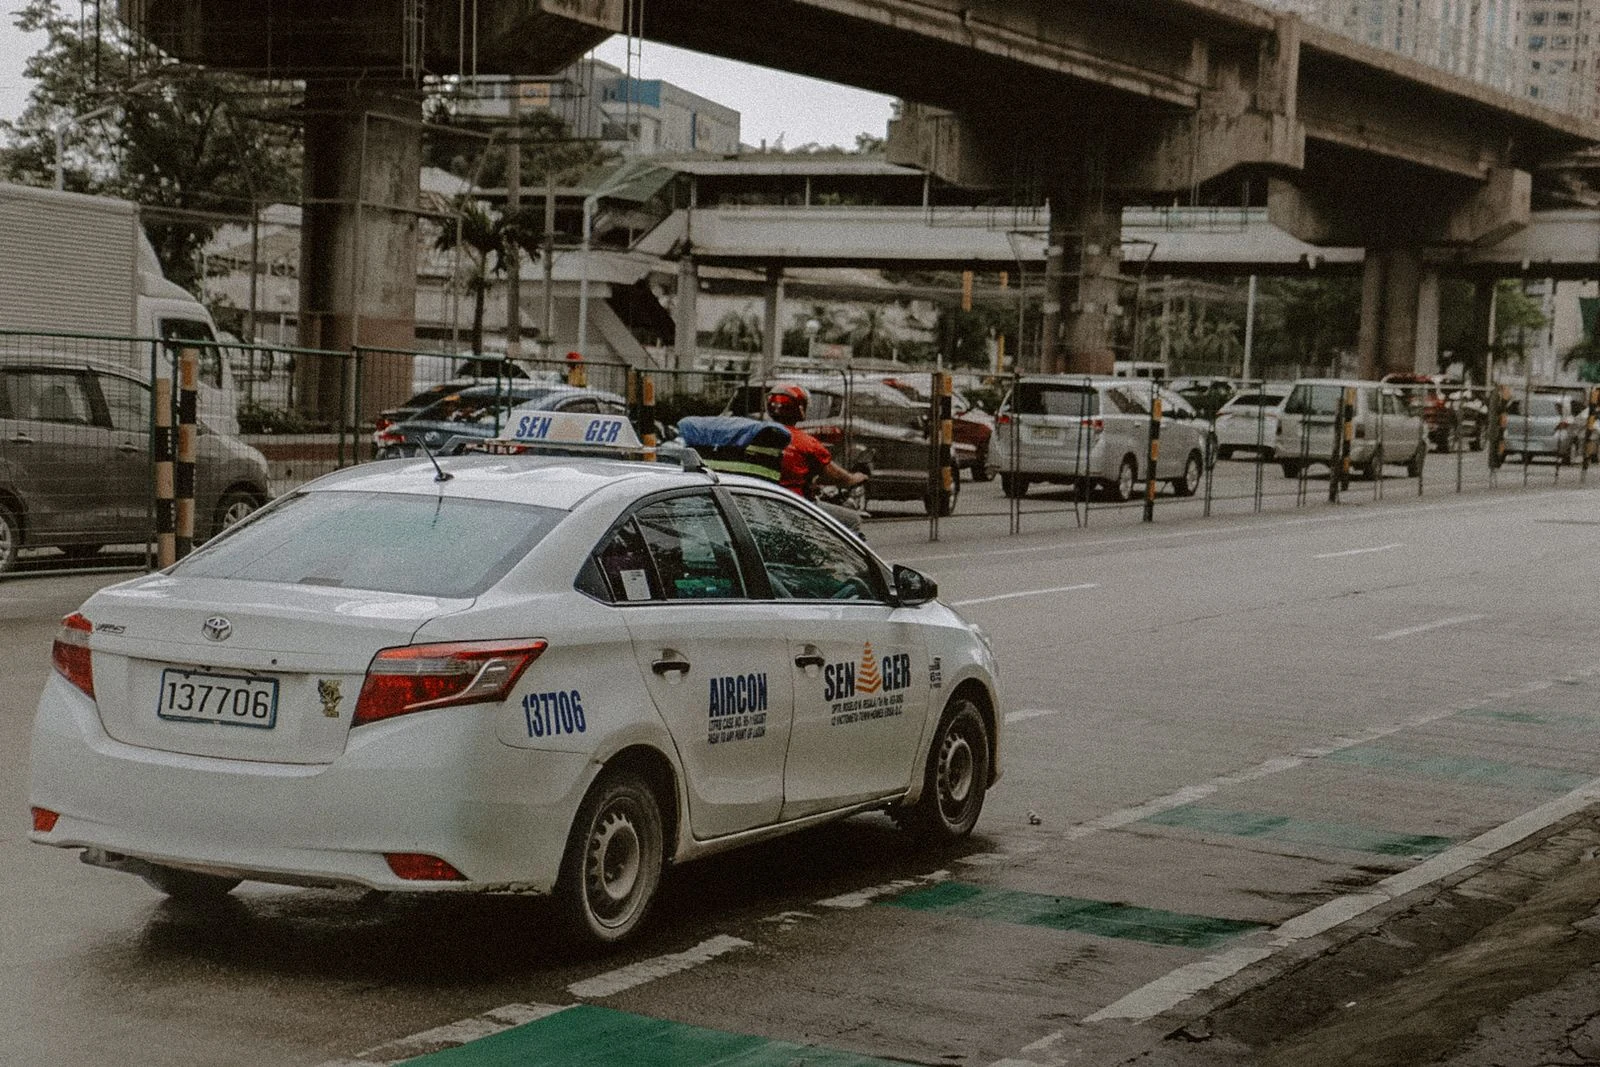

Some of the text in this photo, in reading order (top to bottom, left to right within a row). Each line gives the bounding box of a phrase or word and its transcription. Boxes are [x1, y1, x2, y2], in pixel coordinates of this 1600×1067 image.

[515, 415, 622, 443] SEN GER
[709, 673, 768, 718] AIRCON
[824, 661, 855, 702] SEN
[882, 653, 911, 693] GER
[168, 682, 270, 719] 137706
[522, 690, 587, 738] 137706
